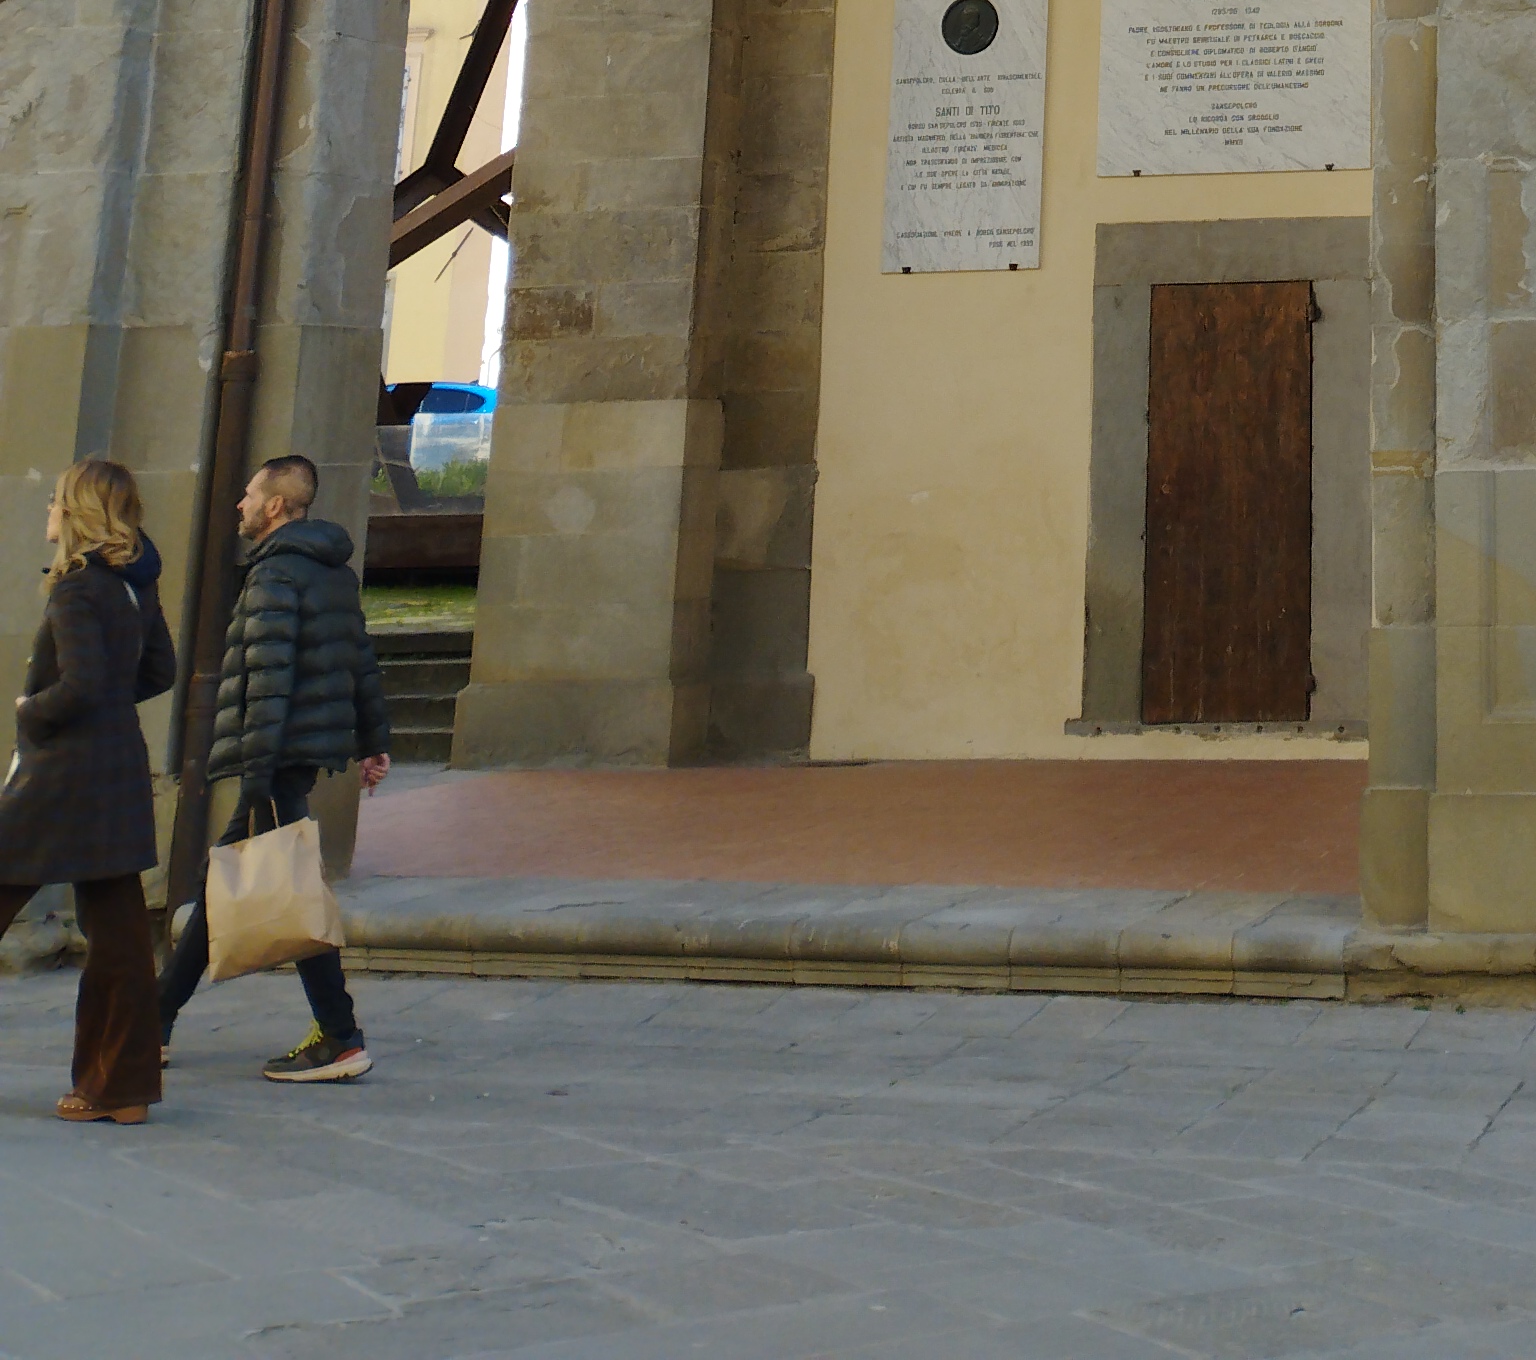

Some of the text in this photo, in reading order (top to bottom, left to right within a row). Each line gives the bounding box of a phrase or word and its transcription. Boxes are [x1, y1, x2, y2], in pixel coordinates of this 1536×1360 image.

[935, 104, 1000, 117] SANTI DI TITO
